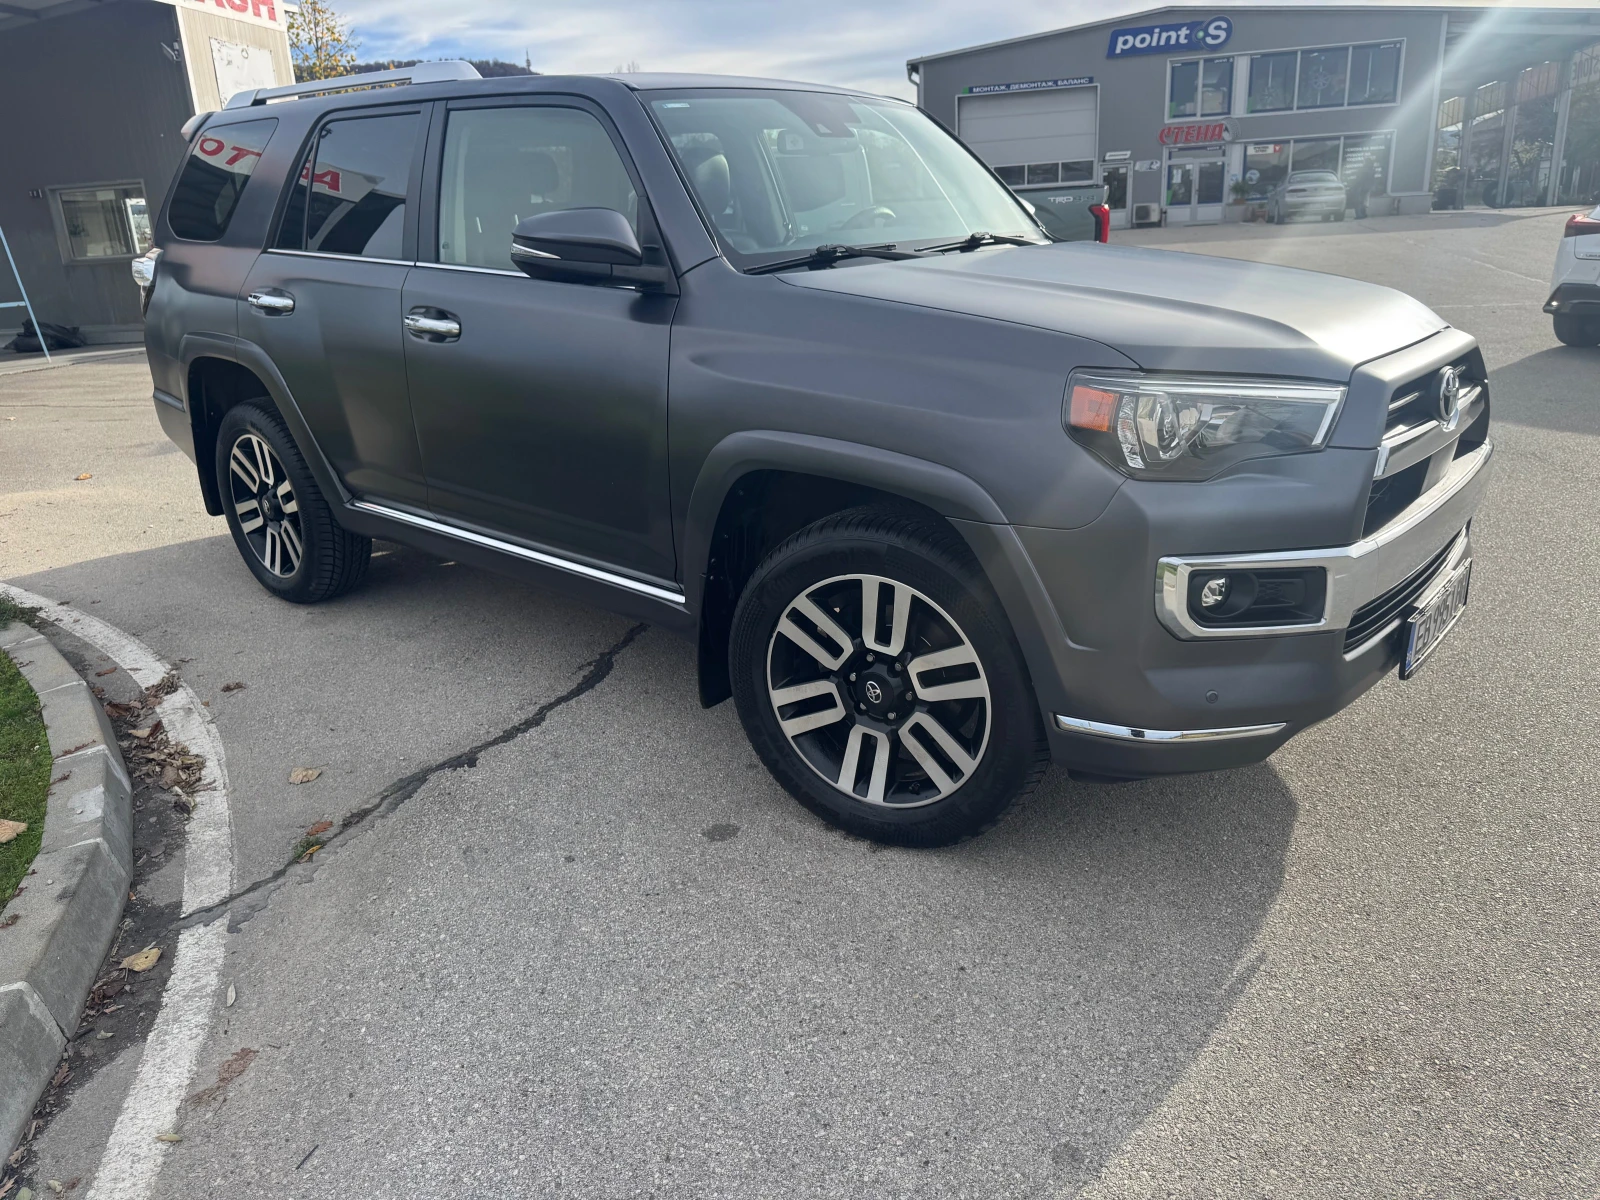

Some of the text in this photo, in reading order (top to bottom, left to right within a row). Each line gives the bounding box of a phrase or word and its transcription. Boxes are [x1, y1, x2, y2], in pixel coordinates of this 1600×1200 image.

[1115, 21, 1228, 54] point S
[972, 78, 1090, 93] МОНТАЖ, ДЕМОНТАЖ, БАЛАНС
[1158, 123, 1225, 144] СТЕНА
[1048, 196, 1073, 204] TRD
